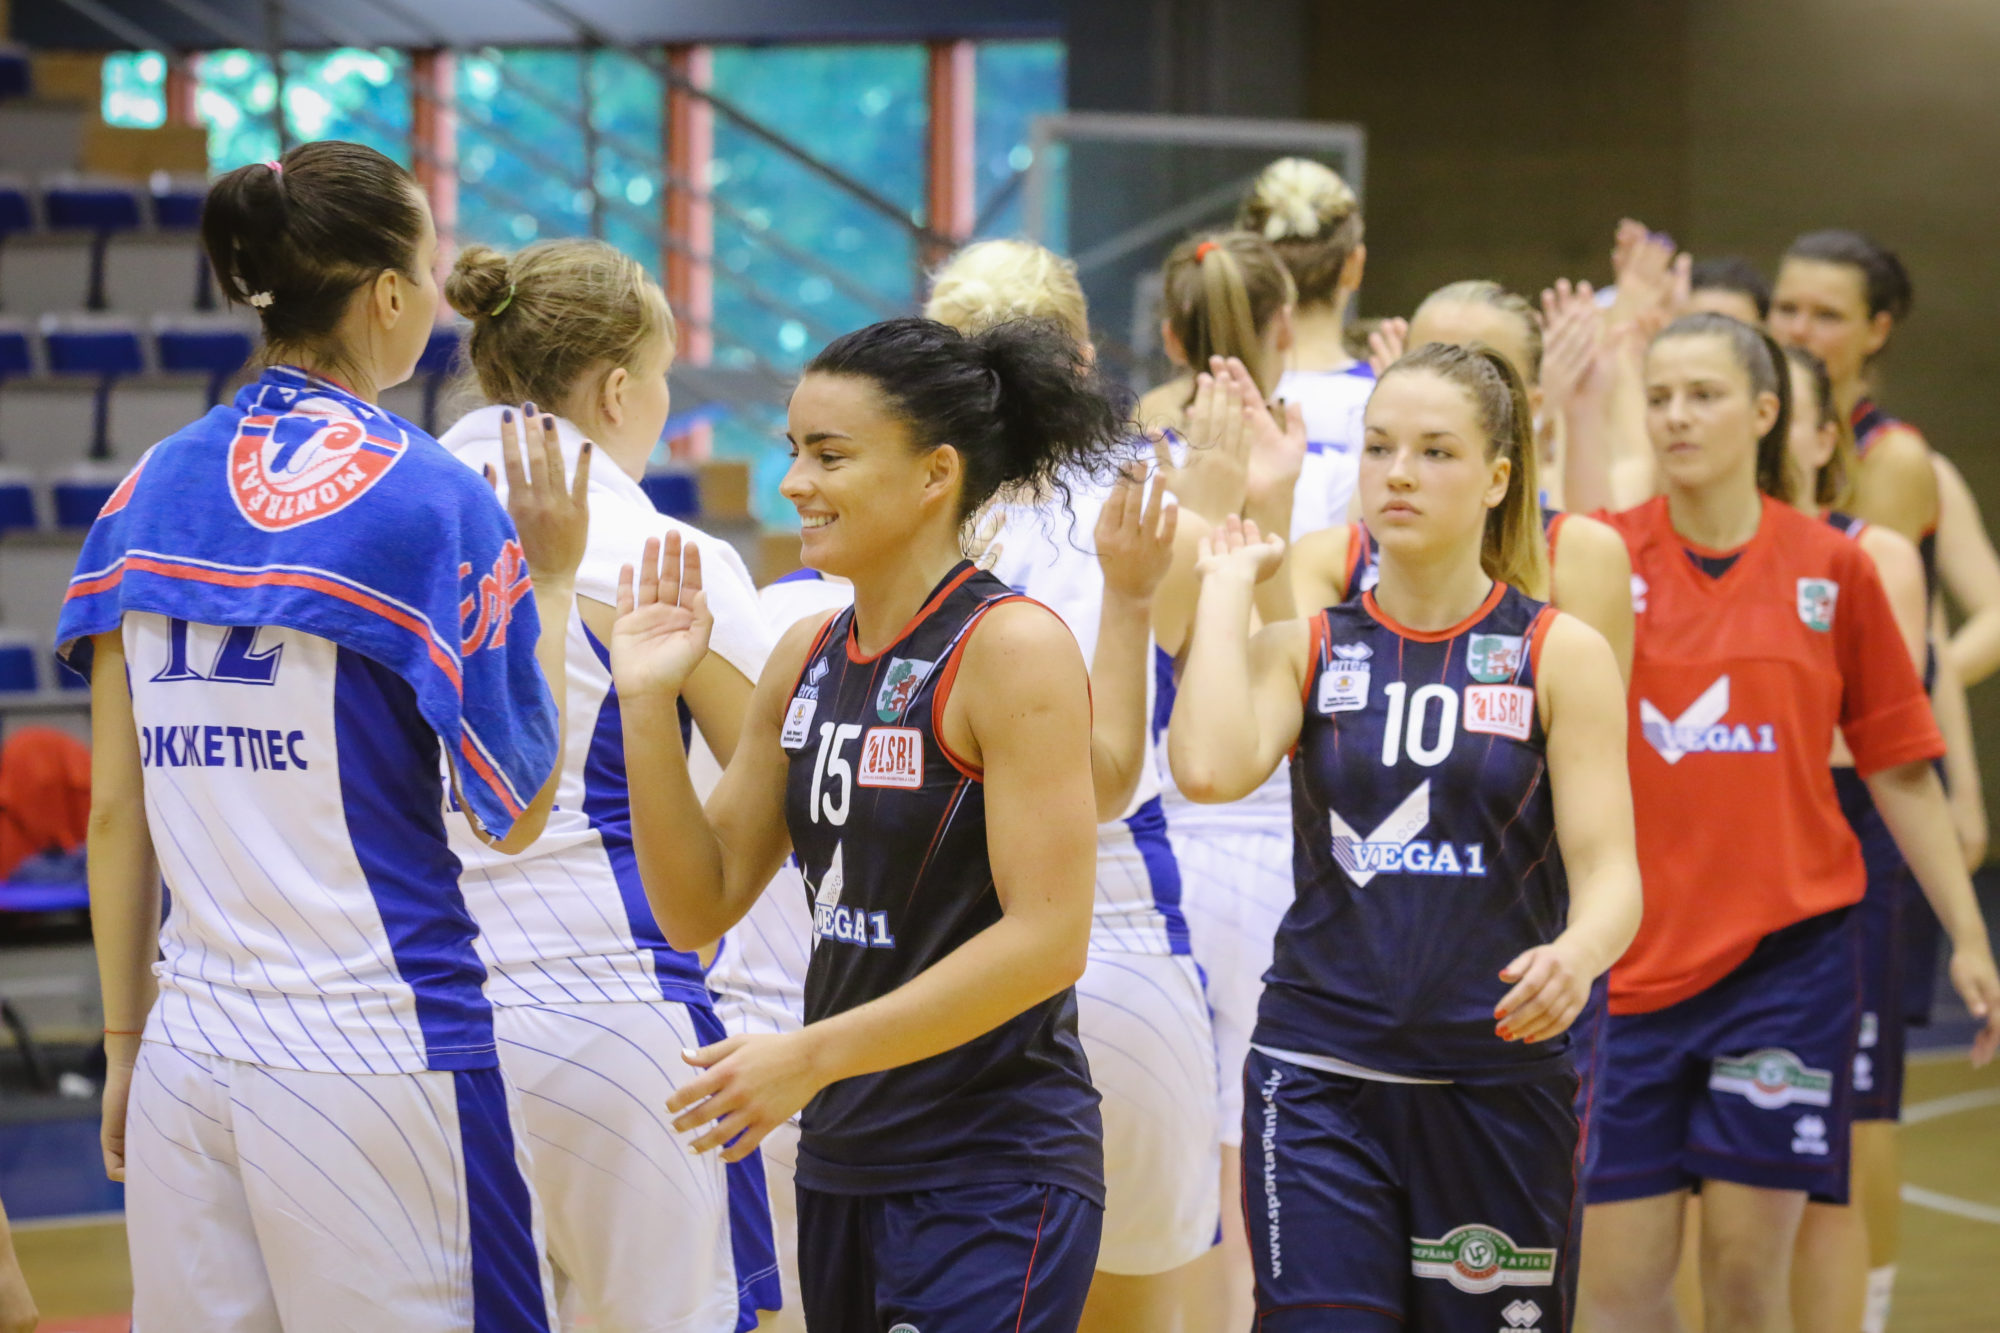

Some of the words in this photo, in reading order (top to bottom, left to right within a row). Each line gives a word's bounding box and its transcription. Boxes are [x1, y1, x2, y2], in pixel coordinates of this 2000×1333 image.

[1381, 681, 1459, 767] 10
[1756, 723, 1777, 753] 1
[810, 721, 863, 826] 15
[877, 735, 916, 775] LSBL
[1350, 841, 1462, 875] VEGA
[1465, 841, 1487, 876] 1
[868, 910, 896, 949] 1
